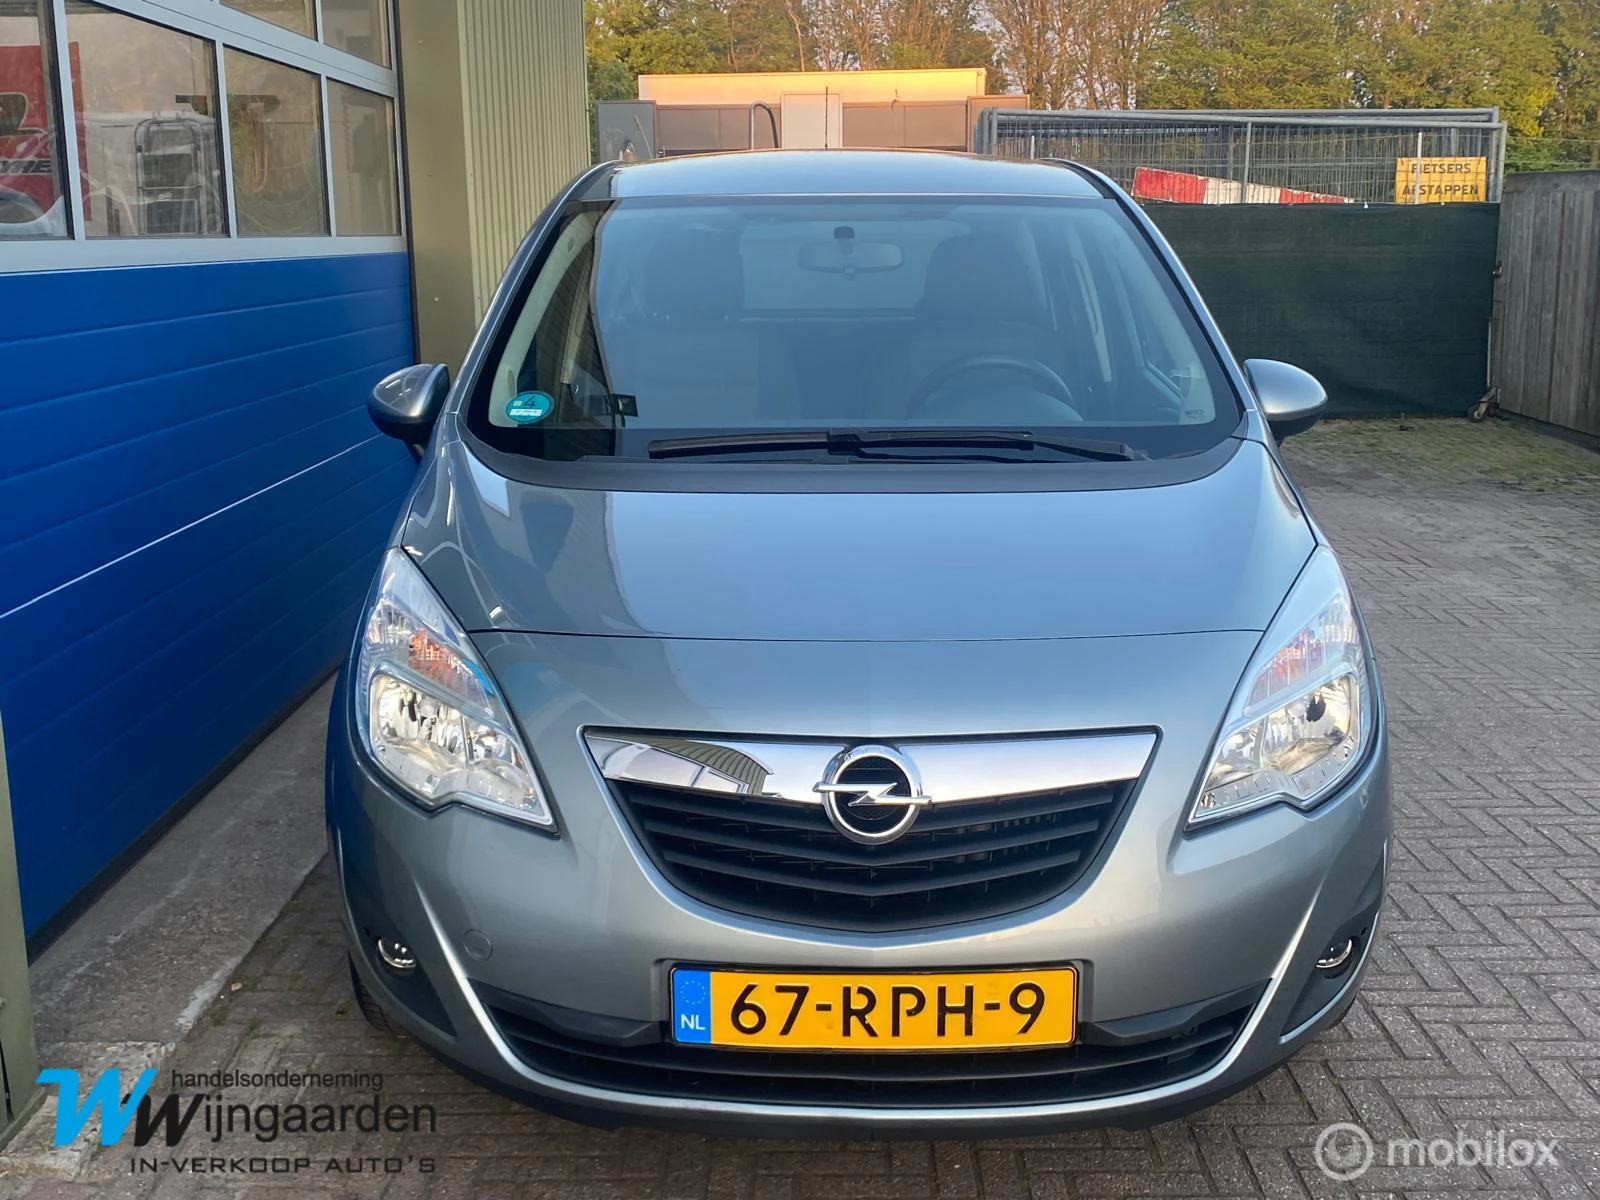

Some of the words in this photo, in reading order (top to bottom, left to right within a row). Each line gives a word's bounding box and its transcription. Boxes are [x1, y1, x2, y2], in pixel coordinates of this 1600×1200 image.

[1411, 163, 1472, 174] FIETSERS
[730, 983, 1046, 1037] 67-RPH-9
[680, 1014, 706, 1031] NL
